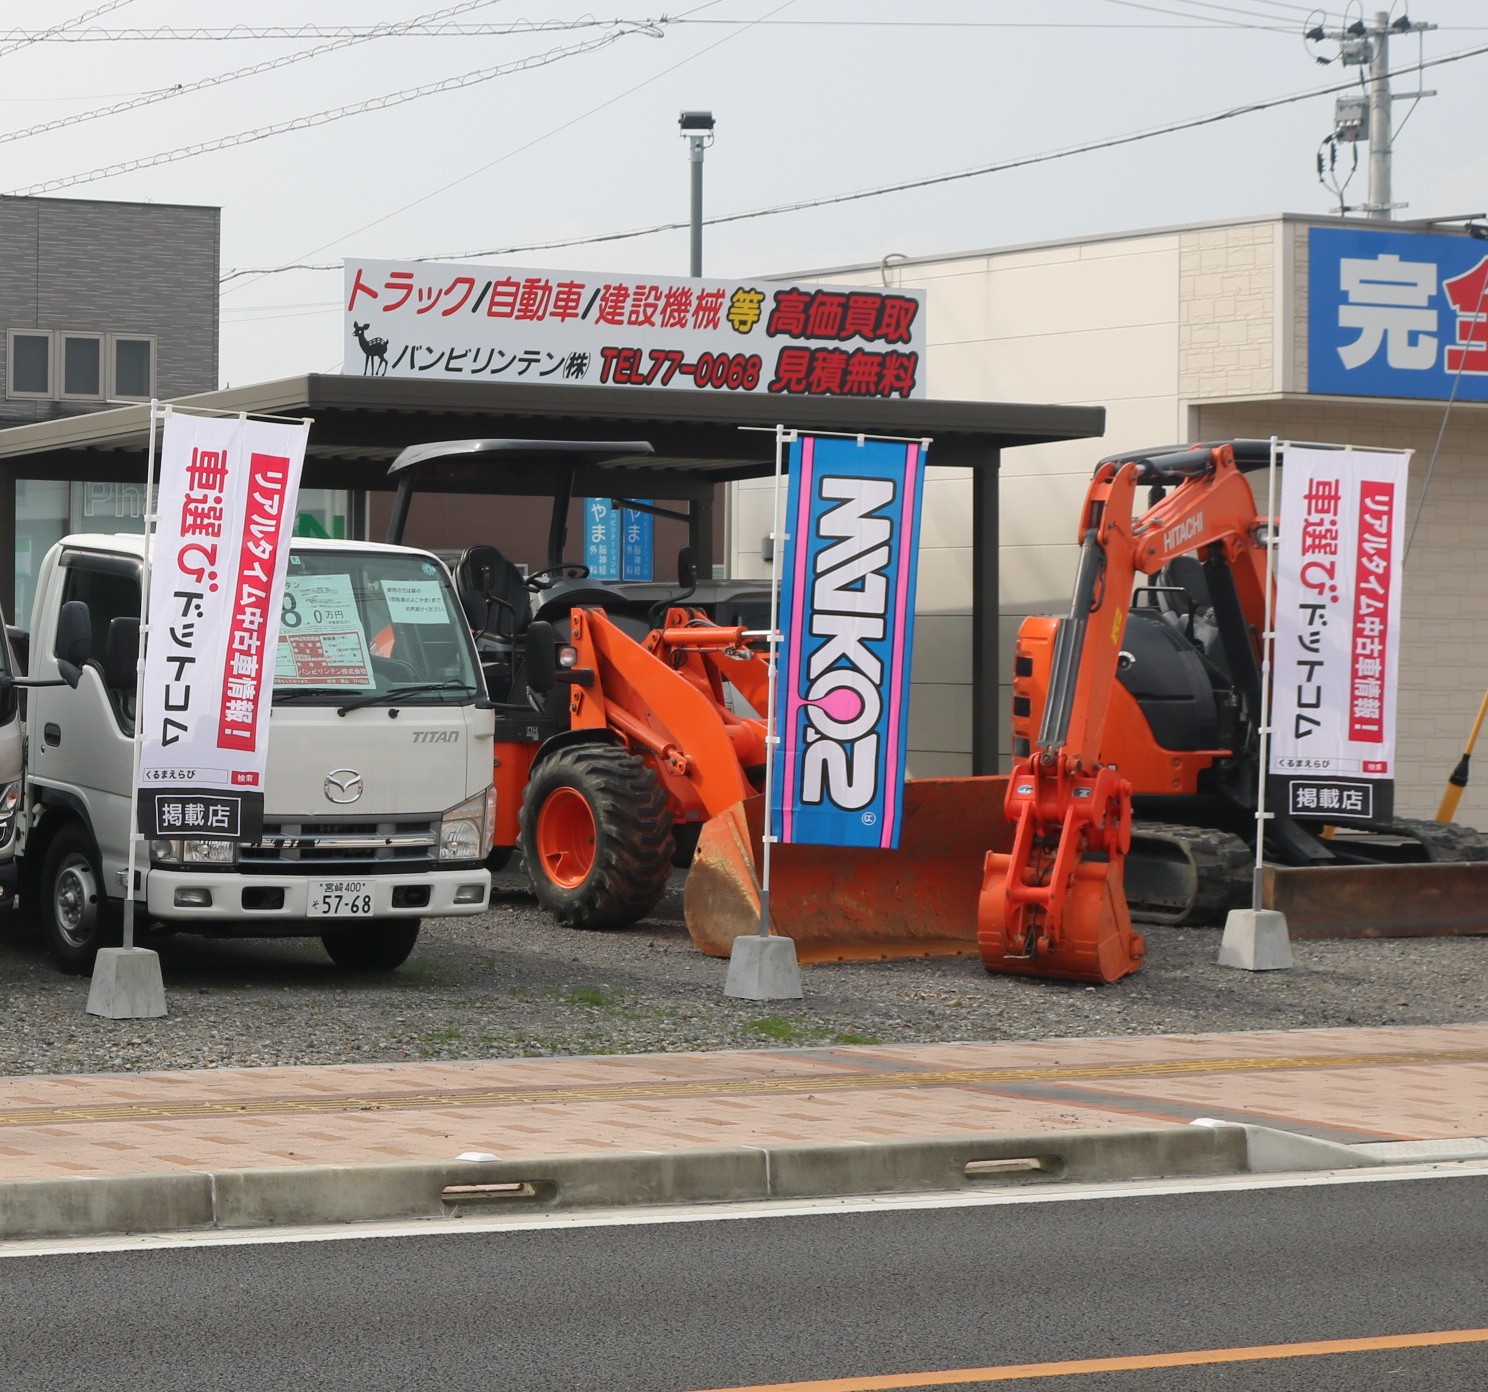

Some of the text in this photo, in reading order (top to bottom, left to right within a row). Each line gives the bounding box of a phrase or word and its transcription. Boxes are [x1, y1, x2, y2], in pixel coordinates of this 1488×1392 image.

[766, 286, 919, 344] 高価買取
[599, 347, 762, 390] TEL77-0068
[768, 345, 918, 398] 見積無料
[1164, 512, 1203, 553] HITACHI
[162, 446, 229, 747] 車選びドットコム
[1295, 477, 1342, 740] 車選びドットコム
[412, 731, 460, 743] TITAN
[145, 769, 196, 780] くるまえらび
[1279, 759, 1330, 769] くるまえらび
[1296, 787, 1363, 811] 掲載店
[162, 803, 231, 828] 掲載店
[322, 895, 372, 914] 57-68
